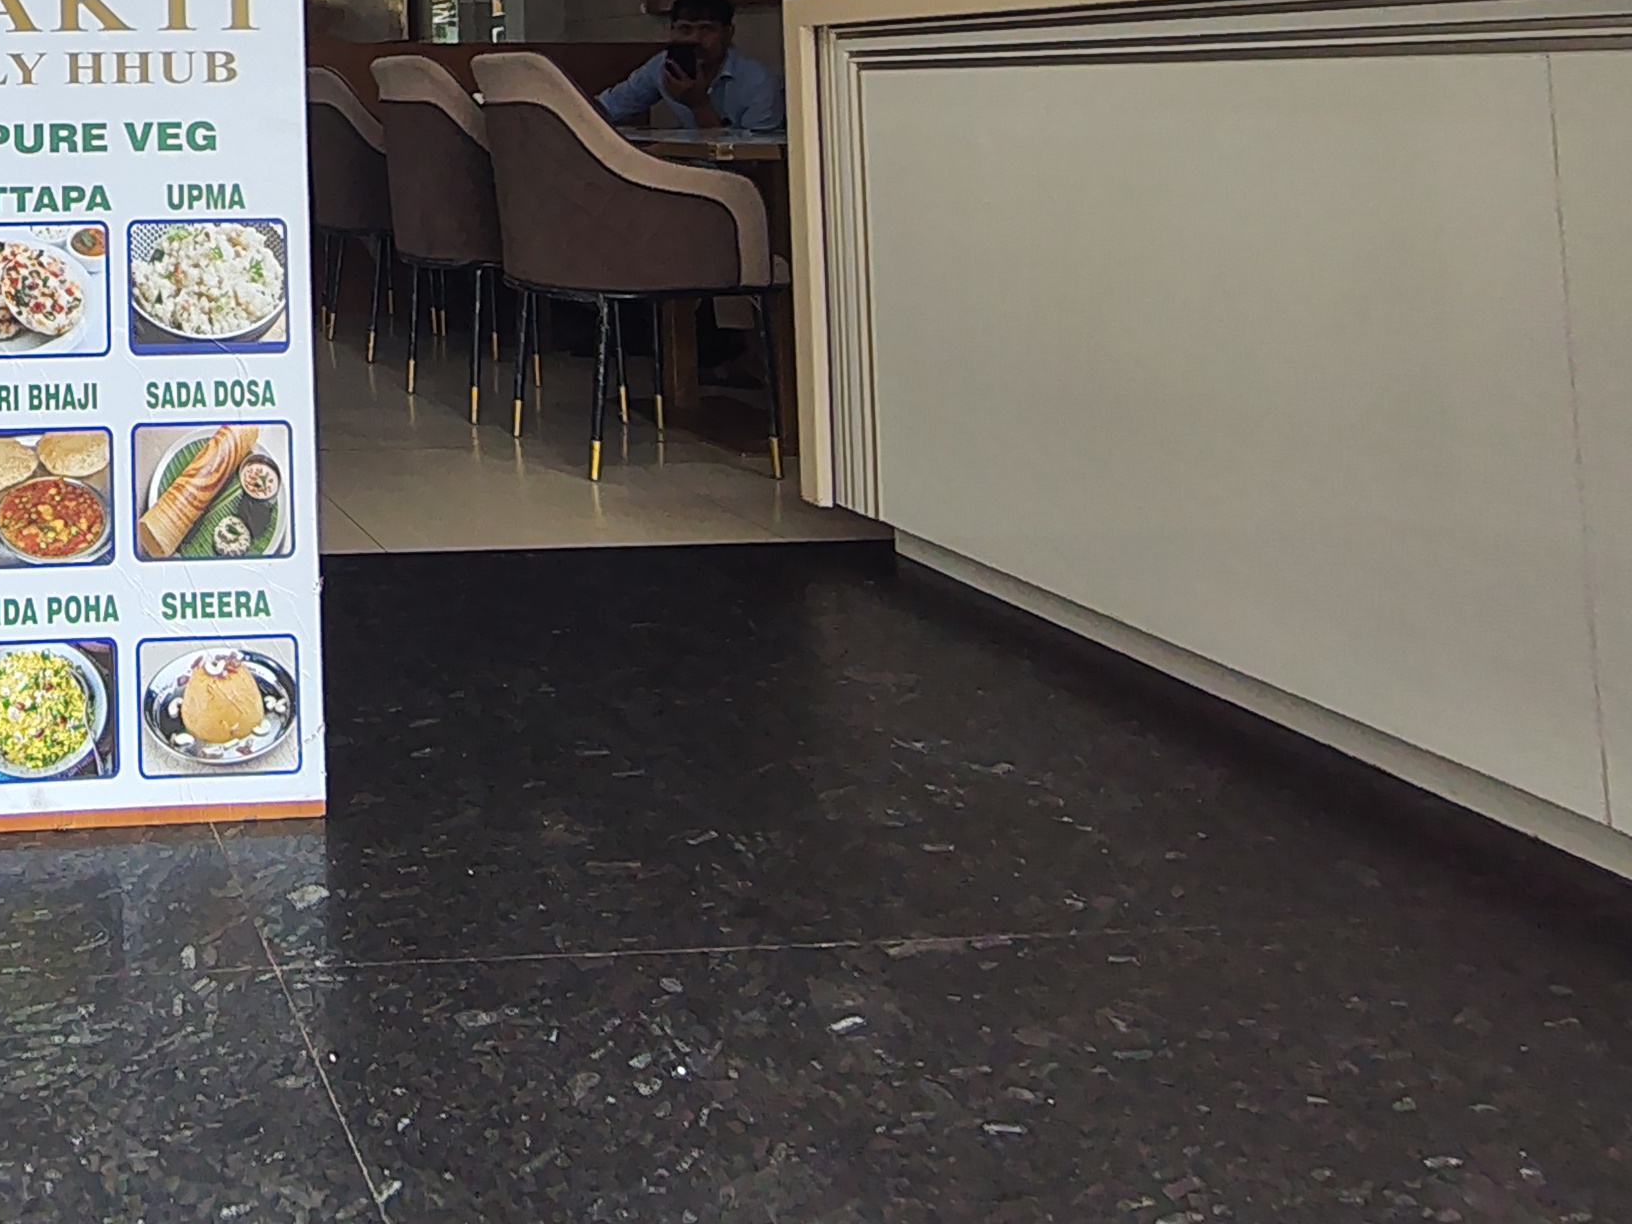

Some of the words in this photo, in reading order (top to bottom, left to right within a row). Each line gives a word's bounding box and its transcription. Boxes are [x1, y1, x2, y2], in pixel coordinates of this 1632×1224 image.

[68, 50, 239, 86] HHUB
[123, 121, 218, 152] VEG
[166, 183, 246, 210] UPMA
[27, 383, 98, 411] BHAJI
[145, 382, 207, 409] SADA
[213, 379, 277, 407] DOSA
[47, 594, 120, 626] POHA
[161, 590, 272, 621] SHEERA
